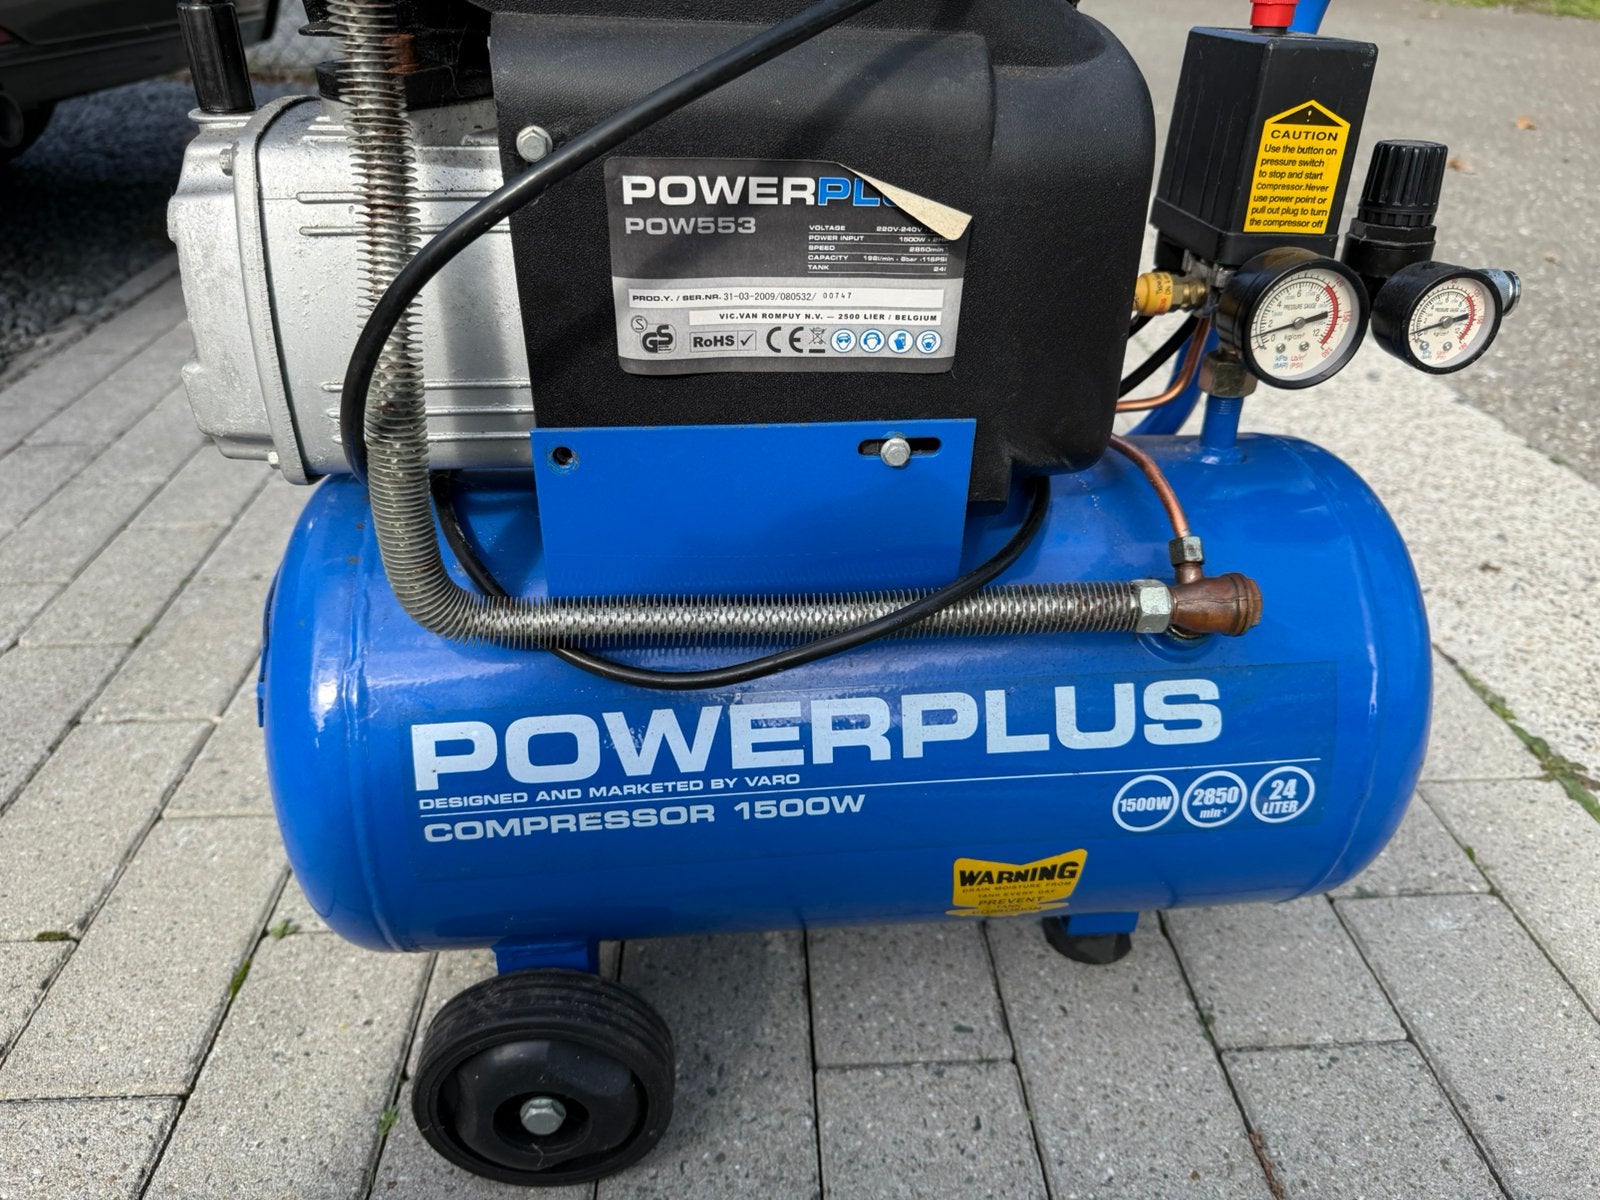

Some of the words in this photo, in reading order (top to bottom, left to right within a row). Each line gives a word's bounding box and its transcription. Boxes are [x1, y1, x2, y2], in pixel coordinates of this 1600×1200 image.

[1270, 129, 1339, 141] CAUTION
[1264, 143, 1281, 153] Use
[1282, 144, 1295, 154] the
[1297, 144, 1324, 155] button
[1325, 147, 1337, 155] on
[1260, 158, 1296, 167] pressure
[1298, 158, 1324, 167] switch
[1258, 170, 1267, 178] to
[1269, 170, 1286, 180] stop
[1287, 170, 1303, 179] and
[1304, 171, 1323, 180] start
[622, 175, 900, 207] POWERPL
[1253, 195, 1268, 203] use
[1269, 196, 1293, 205] power
[1294, 195, 1316, 205] point
[1251, 205, 1266, 215] pull
[1267, 206, 1280, 214] out
[1281, 206, 1298, 217] plug
[1300, 206, 1309, 215] to
[1310, 208, 1328, 216] turn
[625, 216, 756, 235] POW553
[1249, 217, 1261, 226] the
[1262, 219, 1311, 228] compressor
[1312, 219, 1324, 228] off
[632, 294, 673, 302] PROD.Y.
[682, 293, 722, 301] SER.NR.
[1296, 290, 1302, 298] 6
[1315, 294, 1320, 302] 8
[719, 312, 759, 320] VIC.VAN
[761, 312, 801, 320] ROMPUY
[804, 312, 823, 320] N.V.
[894, 314, 938, 322] BELGIUM
[1267, 319, 1273, 328] 2
[642, 324, 674, 353] GS
[1313, 328, 1320, 337] 12
[693, 335, 735, 348] RoHS
[766, 326, 804, 353] CE
[410, 678, 1223, 792] POWERPLUS
[419, 791, 528, 810] DESIGNED
[535, 787, 582, 803] AND
[588, 779, 704, 799] MARKETED
[711, 776, 738, 790] BY
[744, 773, 800, 787] VARO
[1269, 778, 1298, 800] 24
[1191, 786, 1240, 806] 2850
[1119, 795, 1173, 812] 1500W
[1261, 800, 1300, 815] LITER
[423, 803, 715, 843] COMPRESSOR
[733, 794, 866, 821] 1500W
[959, 861, 1080, 887] WARNING
[962, 886, 991, 894] DRAIN
[994, 882, 1041, 891] MOISTURE
[1003, 889, 1034, 897] EVERY
[977, 895, 1046, 906] PREVENT
